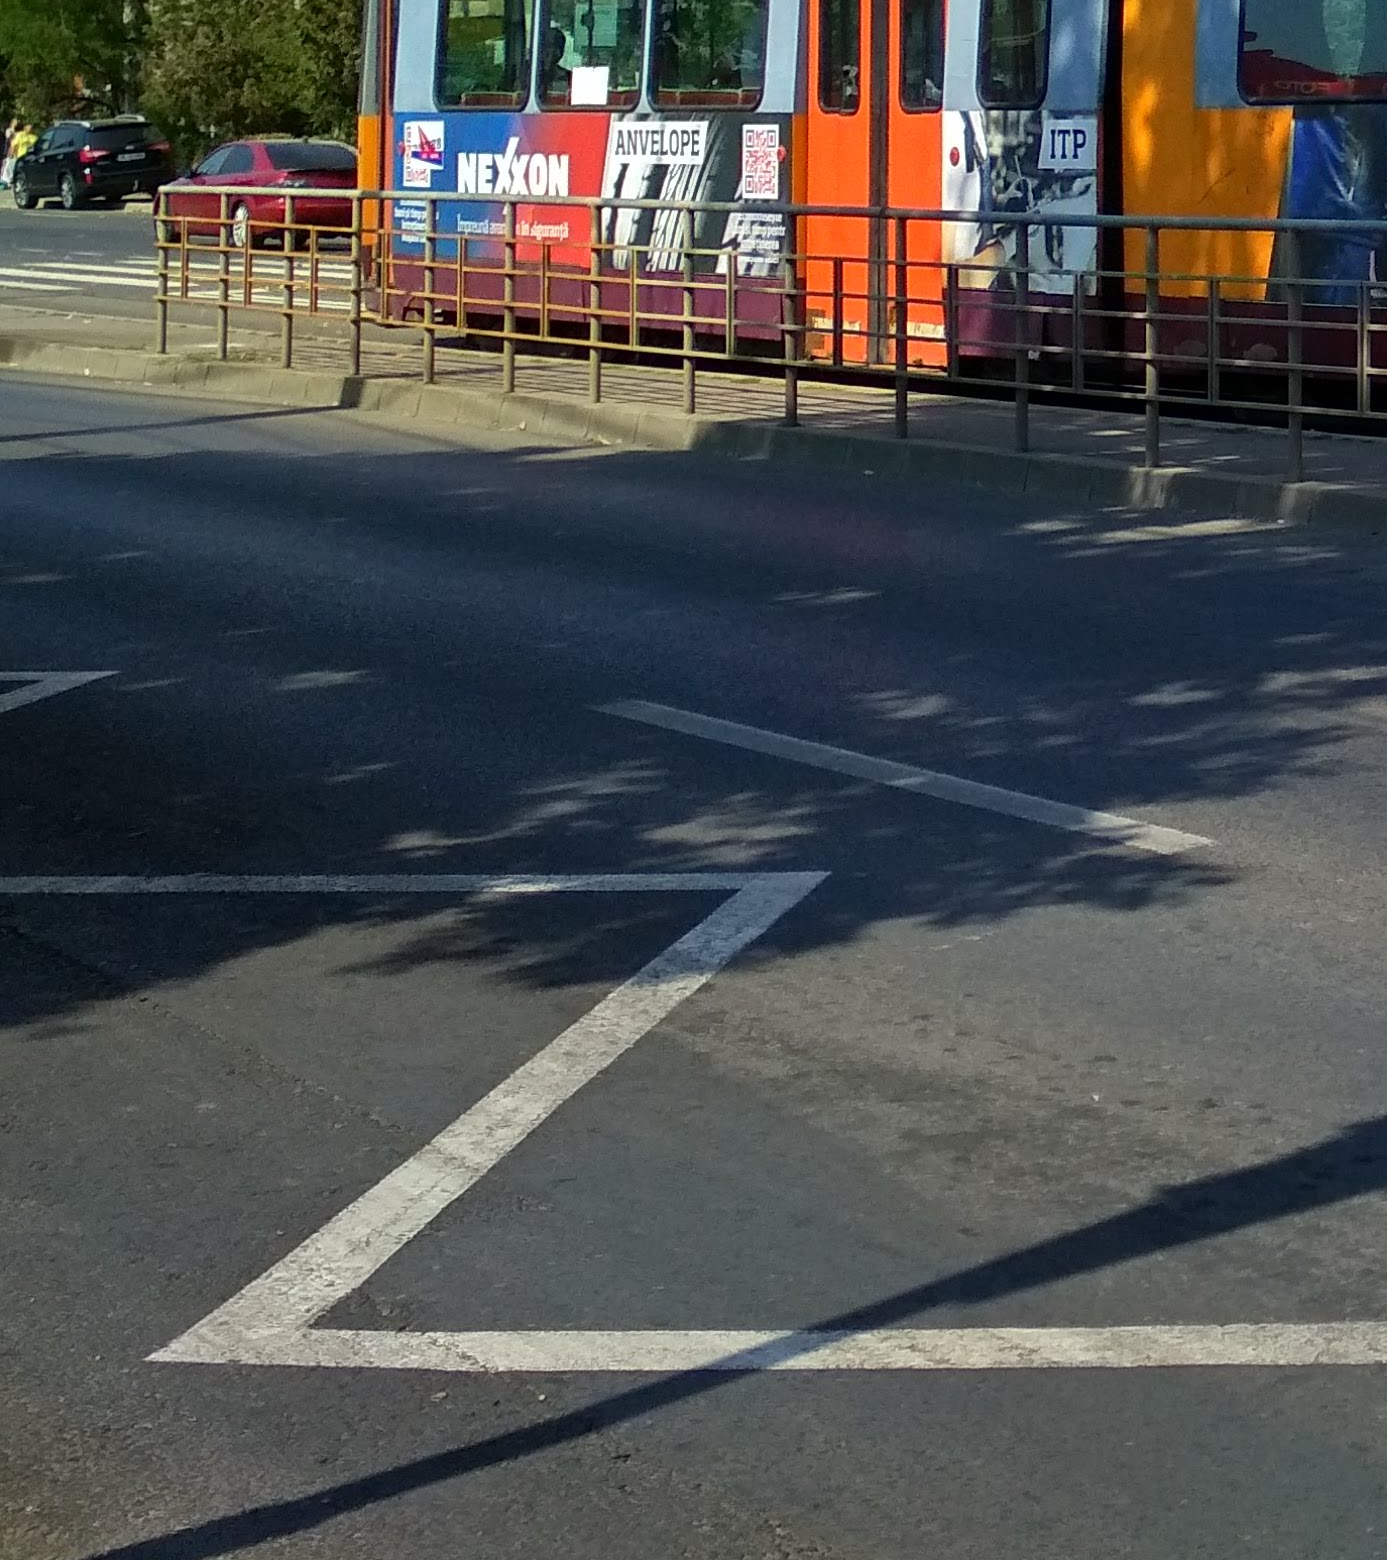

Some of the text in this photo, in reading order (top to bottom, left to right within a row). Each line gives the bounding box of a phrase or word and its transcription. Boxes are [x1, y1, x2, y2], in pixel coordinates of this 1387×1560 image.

[615, 129, 700, 157] ANVELOPE
[1050, 129, 1087, 159] ITP
[457, 136, 569, 197] NEXXON
